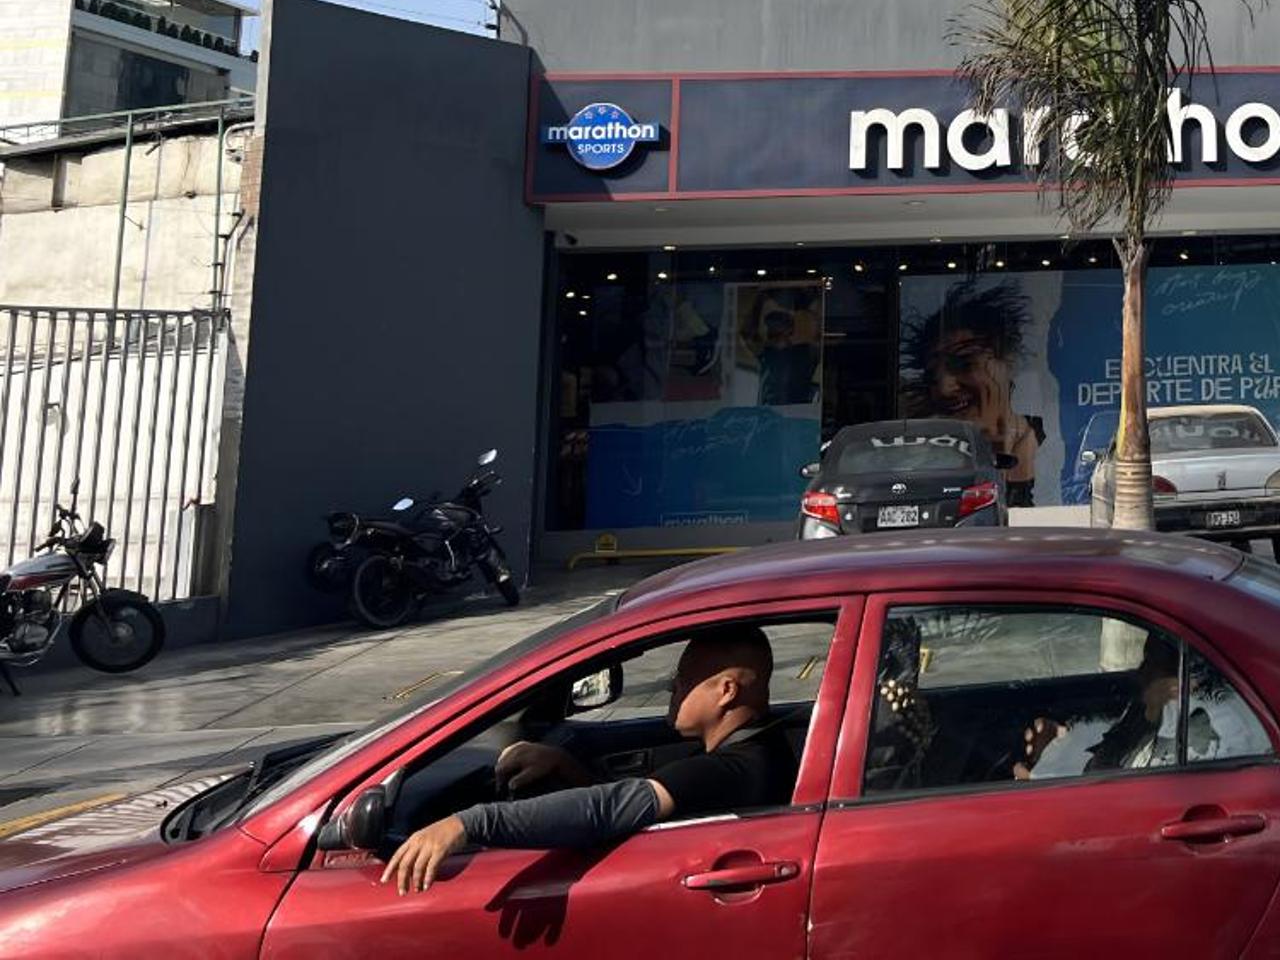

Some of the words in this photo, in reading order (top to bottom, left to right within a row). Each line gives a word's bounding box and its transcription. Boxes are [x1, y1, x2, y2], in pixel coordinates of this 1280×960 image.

[548, 122, 655, 140] marathon
[578, 143, 624, 154] SPORTS
[1105, 354, 1243, 379] ECUENTRA
[1078, 379, 1193, 406] DEPRTE
[1201, 377, 1233, 401] DE
